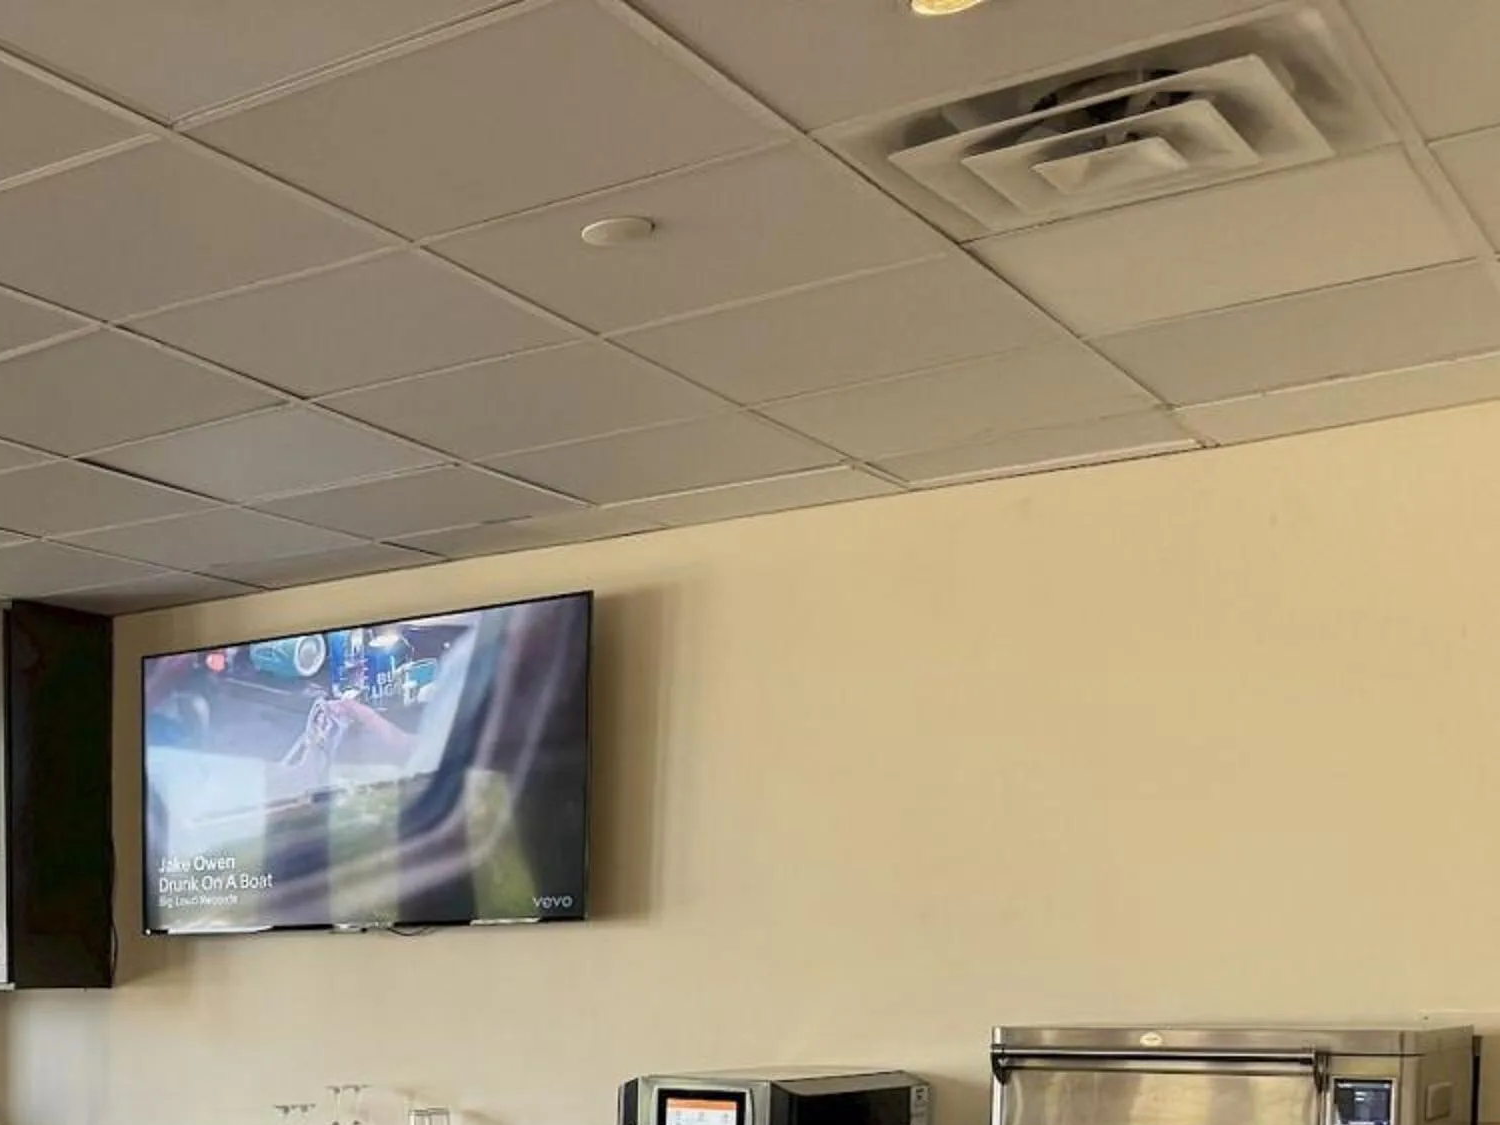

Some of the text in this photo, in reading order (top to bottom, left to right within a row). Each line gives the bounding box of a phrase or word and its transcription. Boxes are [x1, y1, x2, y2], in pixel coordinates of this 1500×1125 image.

[194, 855, 236, 871] Owen
[159, 872, 273, 894] Drunk On A Boat
